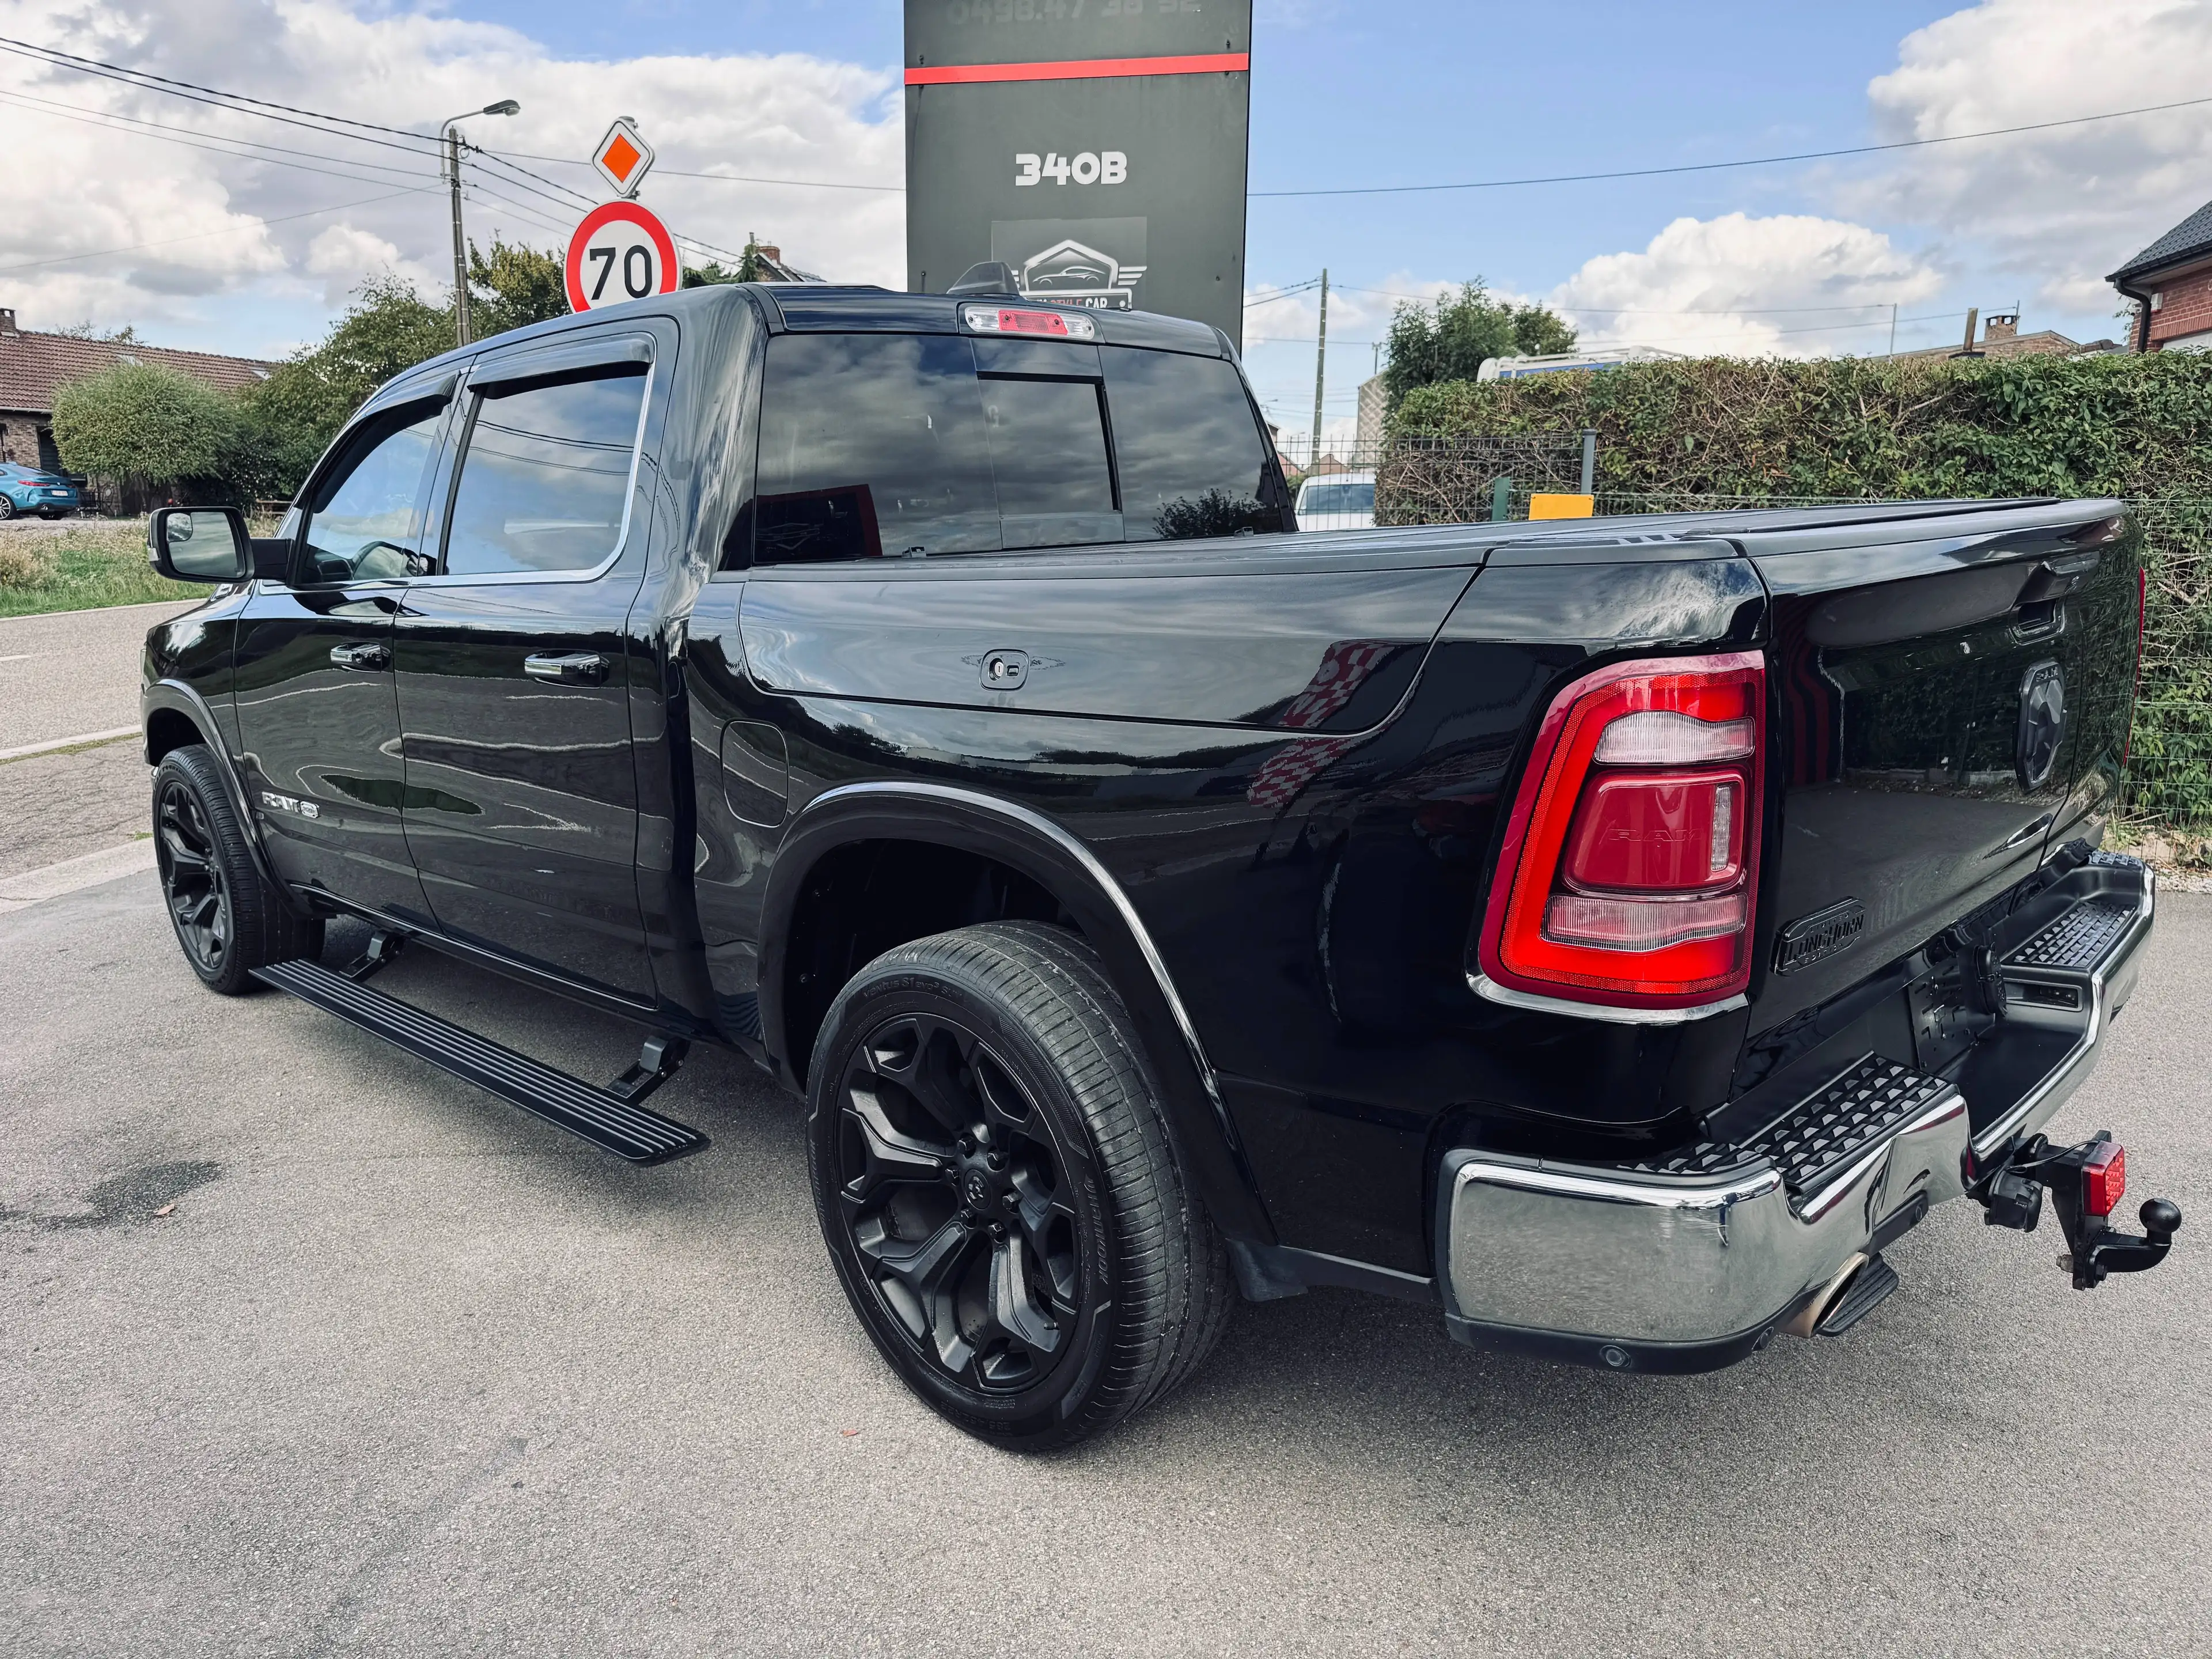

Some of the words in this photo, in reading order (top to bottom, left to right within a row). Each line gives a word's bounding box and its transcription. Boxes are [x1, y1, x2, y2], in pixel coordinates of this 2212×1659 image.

[1015, 151, 1127, 186] 340B
[589, 244, 653, 300] 70
[1085, 297, 1108, 308] CAR
[1608, 828, 1703, 842] RAM
[1784, 914, 1866, 965] LONGHORN
